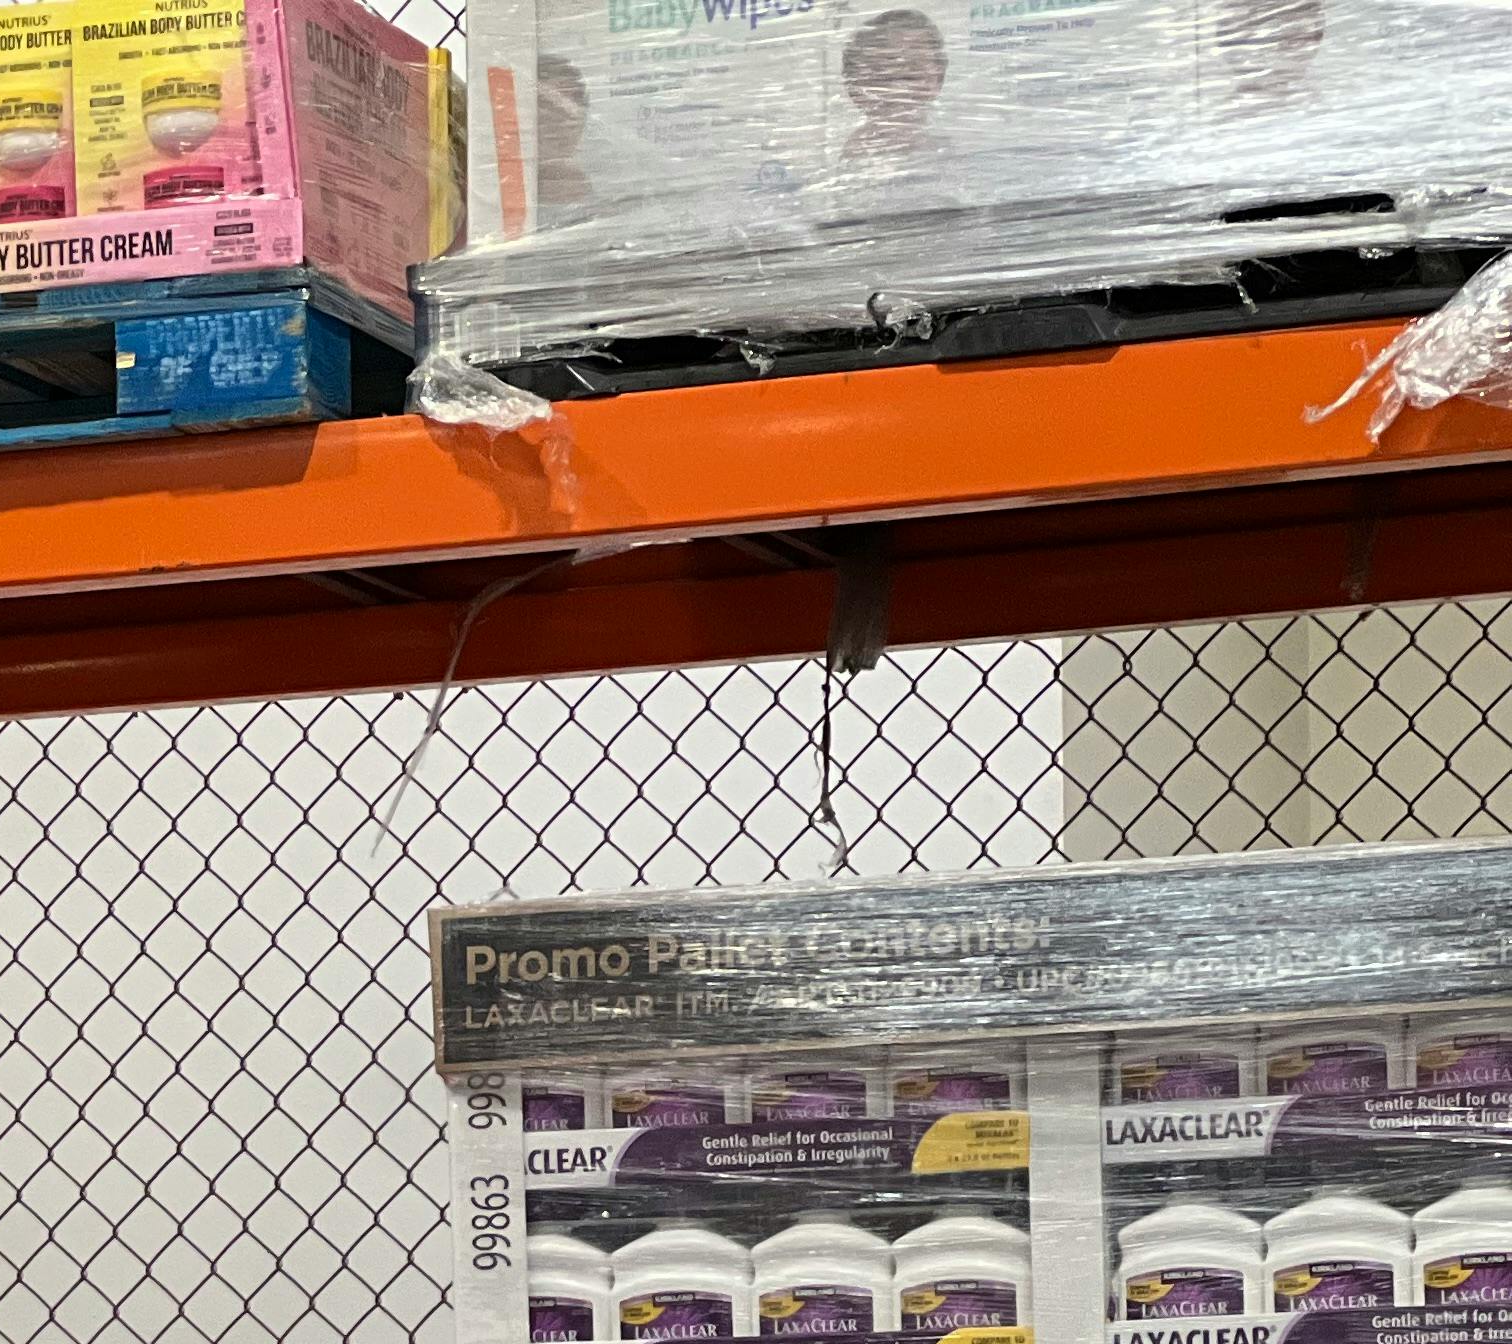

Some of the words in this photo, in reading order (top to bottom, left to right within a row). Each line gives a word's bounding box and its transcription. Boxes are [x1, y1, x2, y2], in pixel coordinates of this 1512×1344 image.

[16, 238, 95, 269] BUTTER
[100, 230, 173, 263] CREAM
[466, 940, 630, 985] Promo
[465, 998, 653, 1029] LAXACLEAR
[1105, 1112, 1264, 1146] LAXACLEAR
[471, 1175, 511, 1270] 99863
